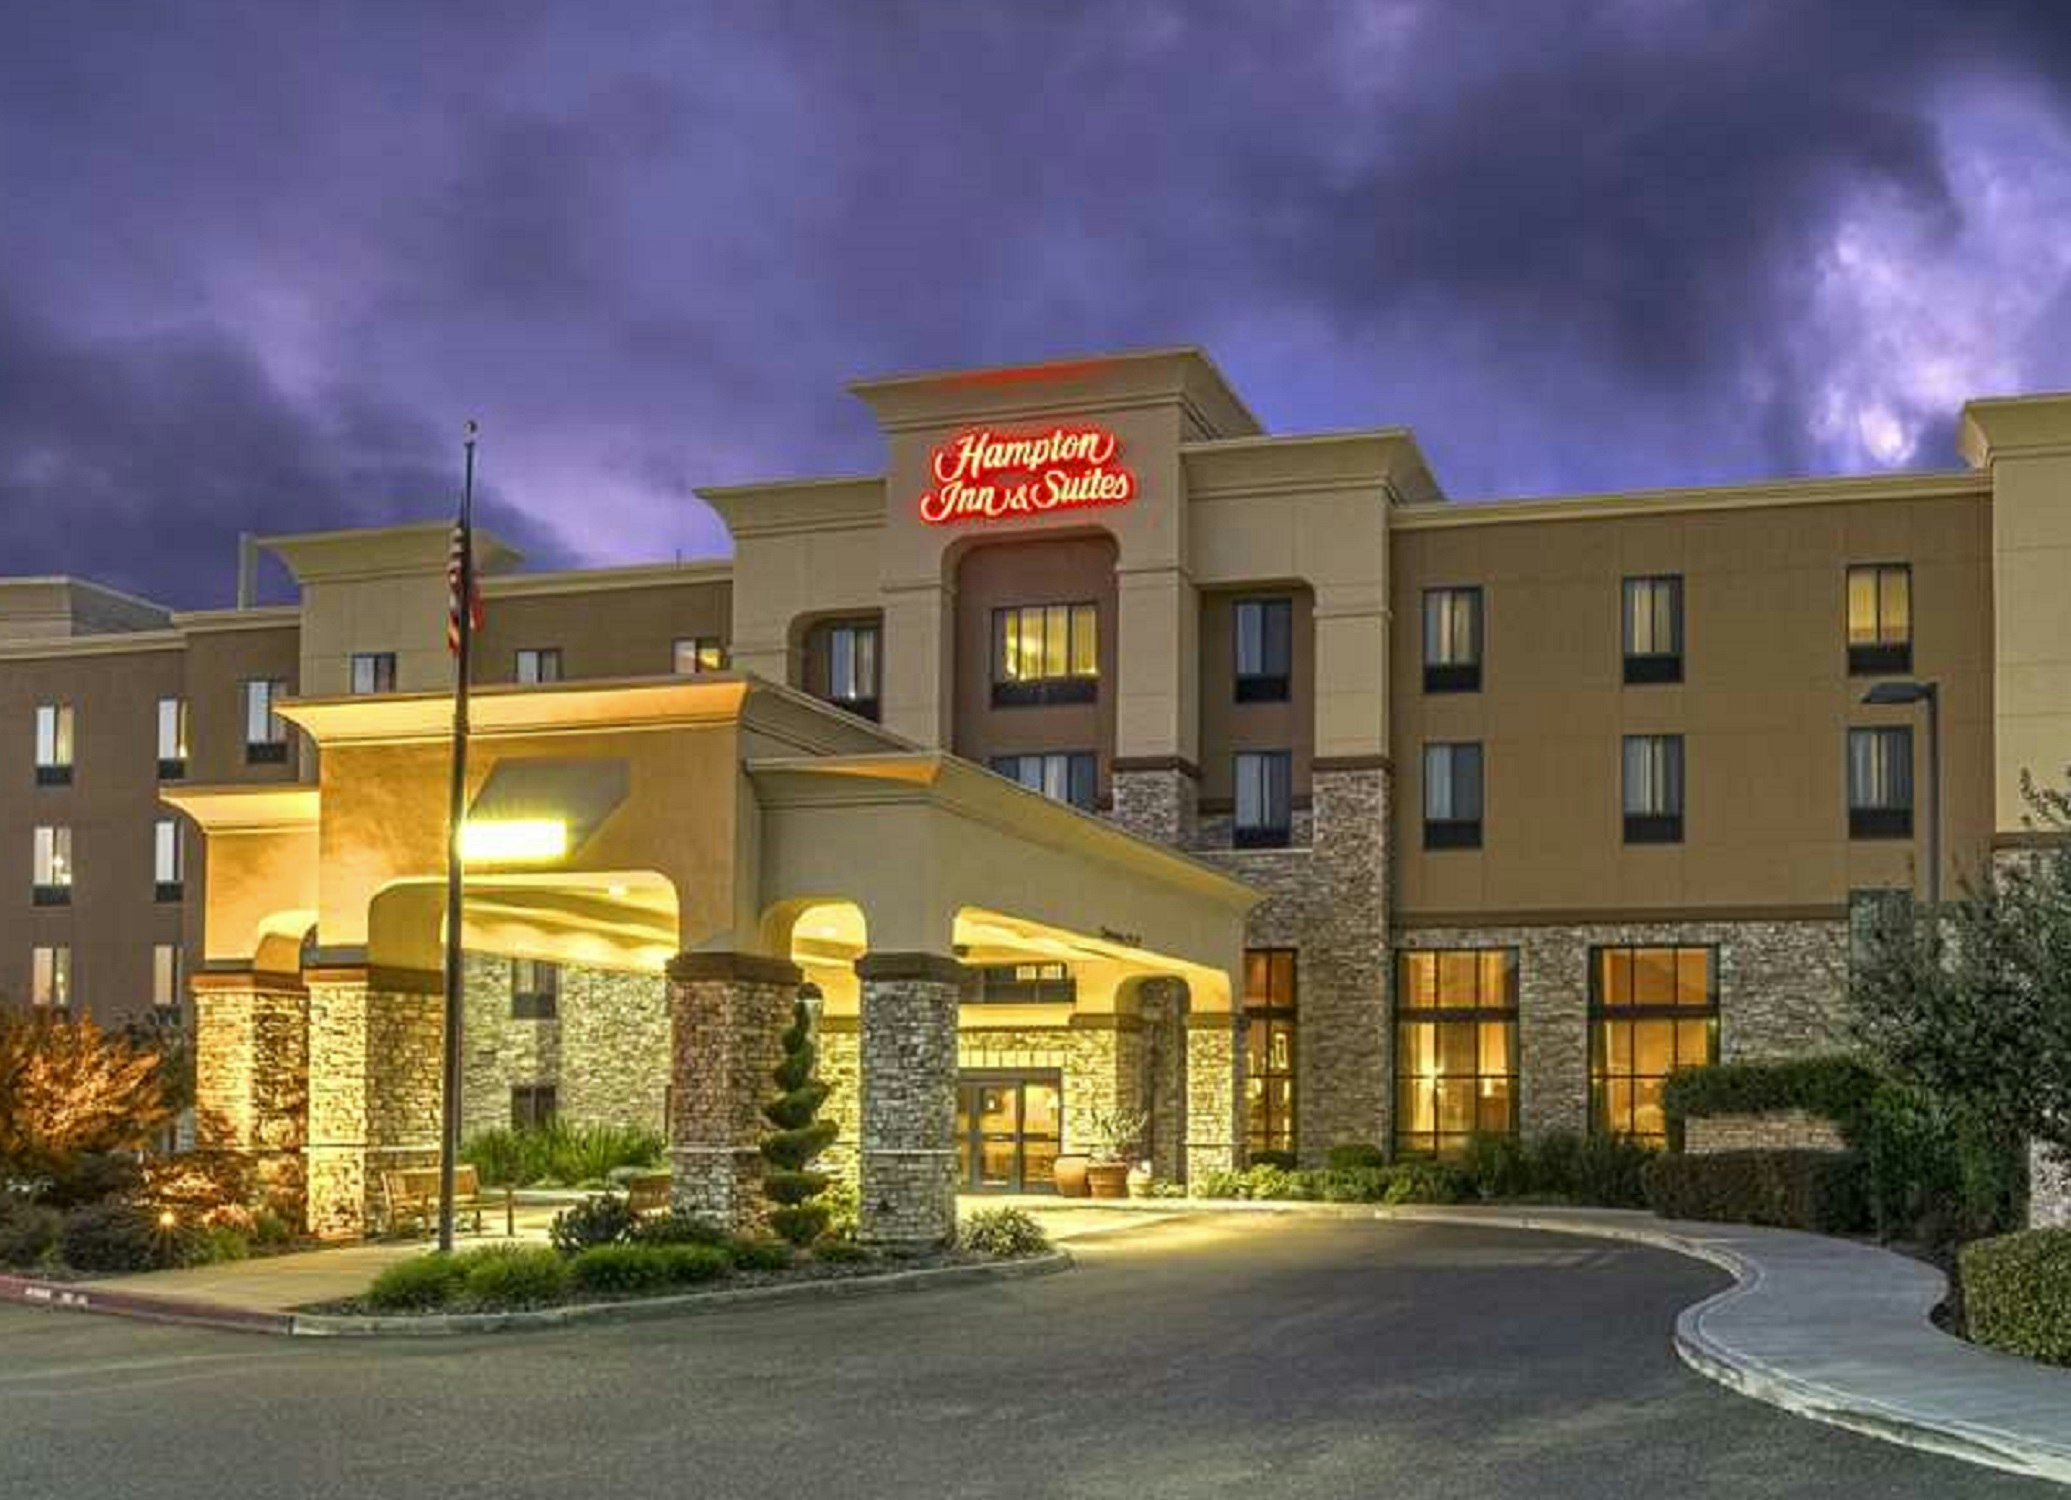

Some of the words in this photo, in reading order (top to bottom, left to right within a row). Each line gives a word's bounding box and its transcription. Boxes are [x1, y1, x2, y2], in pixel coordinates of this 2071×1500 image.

[934, 430, 1114, 482] Hampton
[920, 481, 1007, 521] Inn
[1030, 467, 1128, 509] Suites
